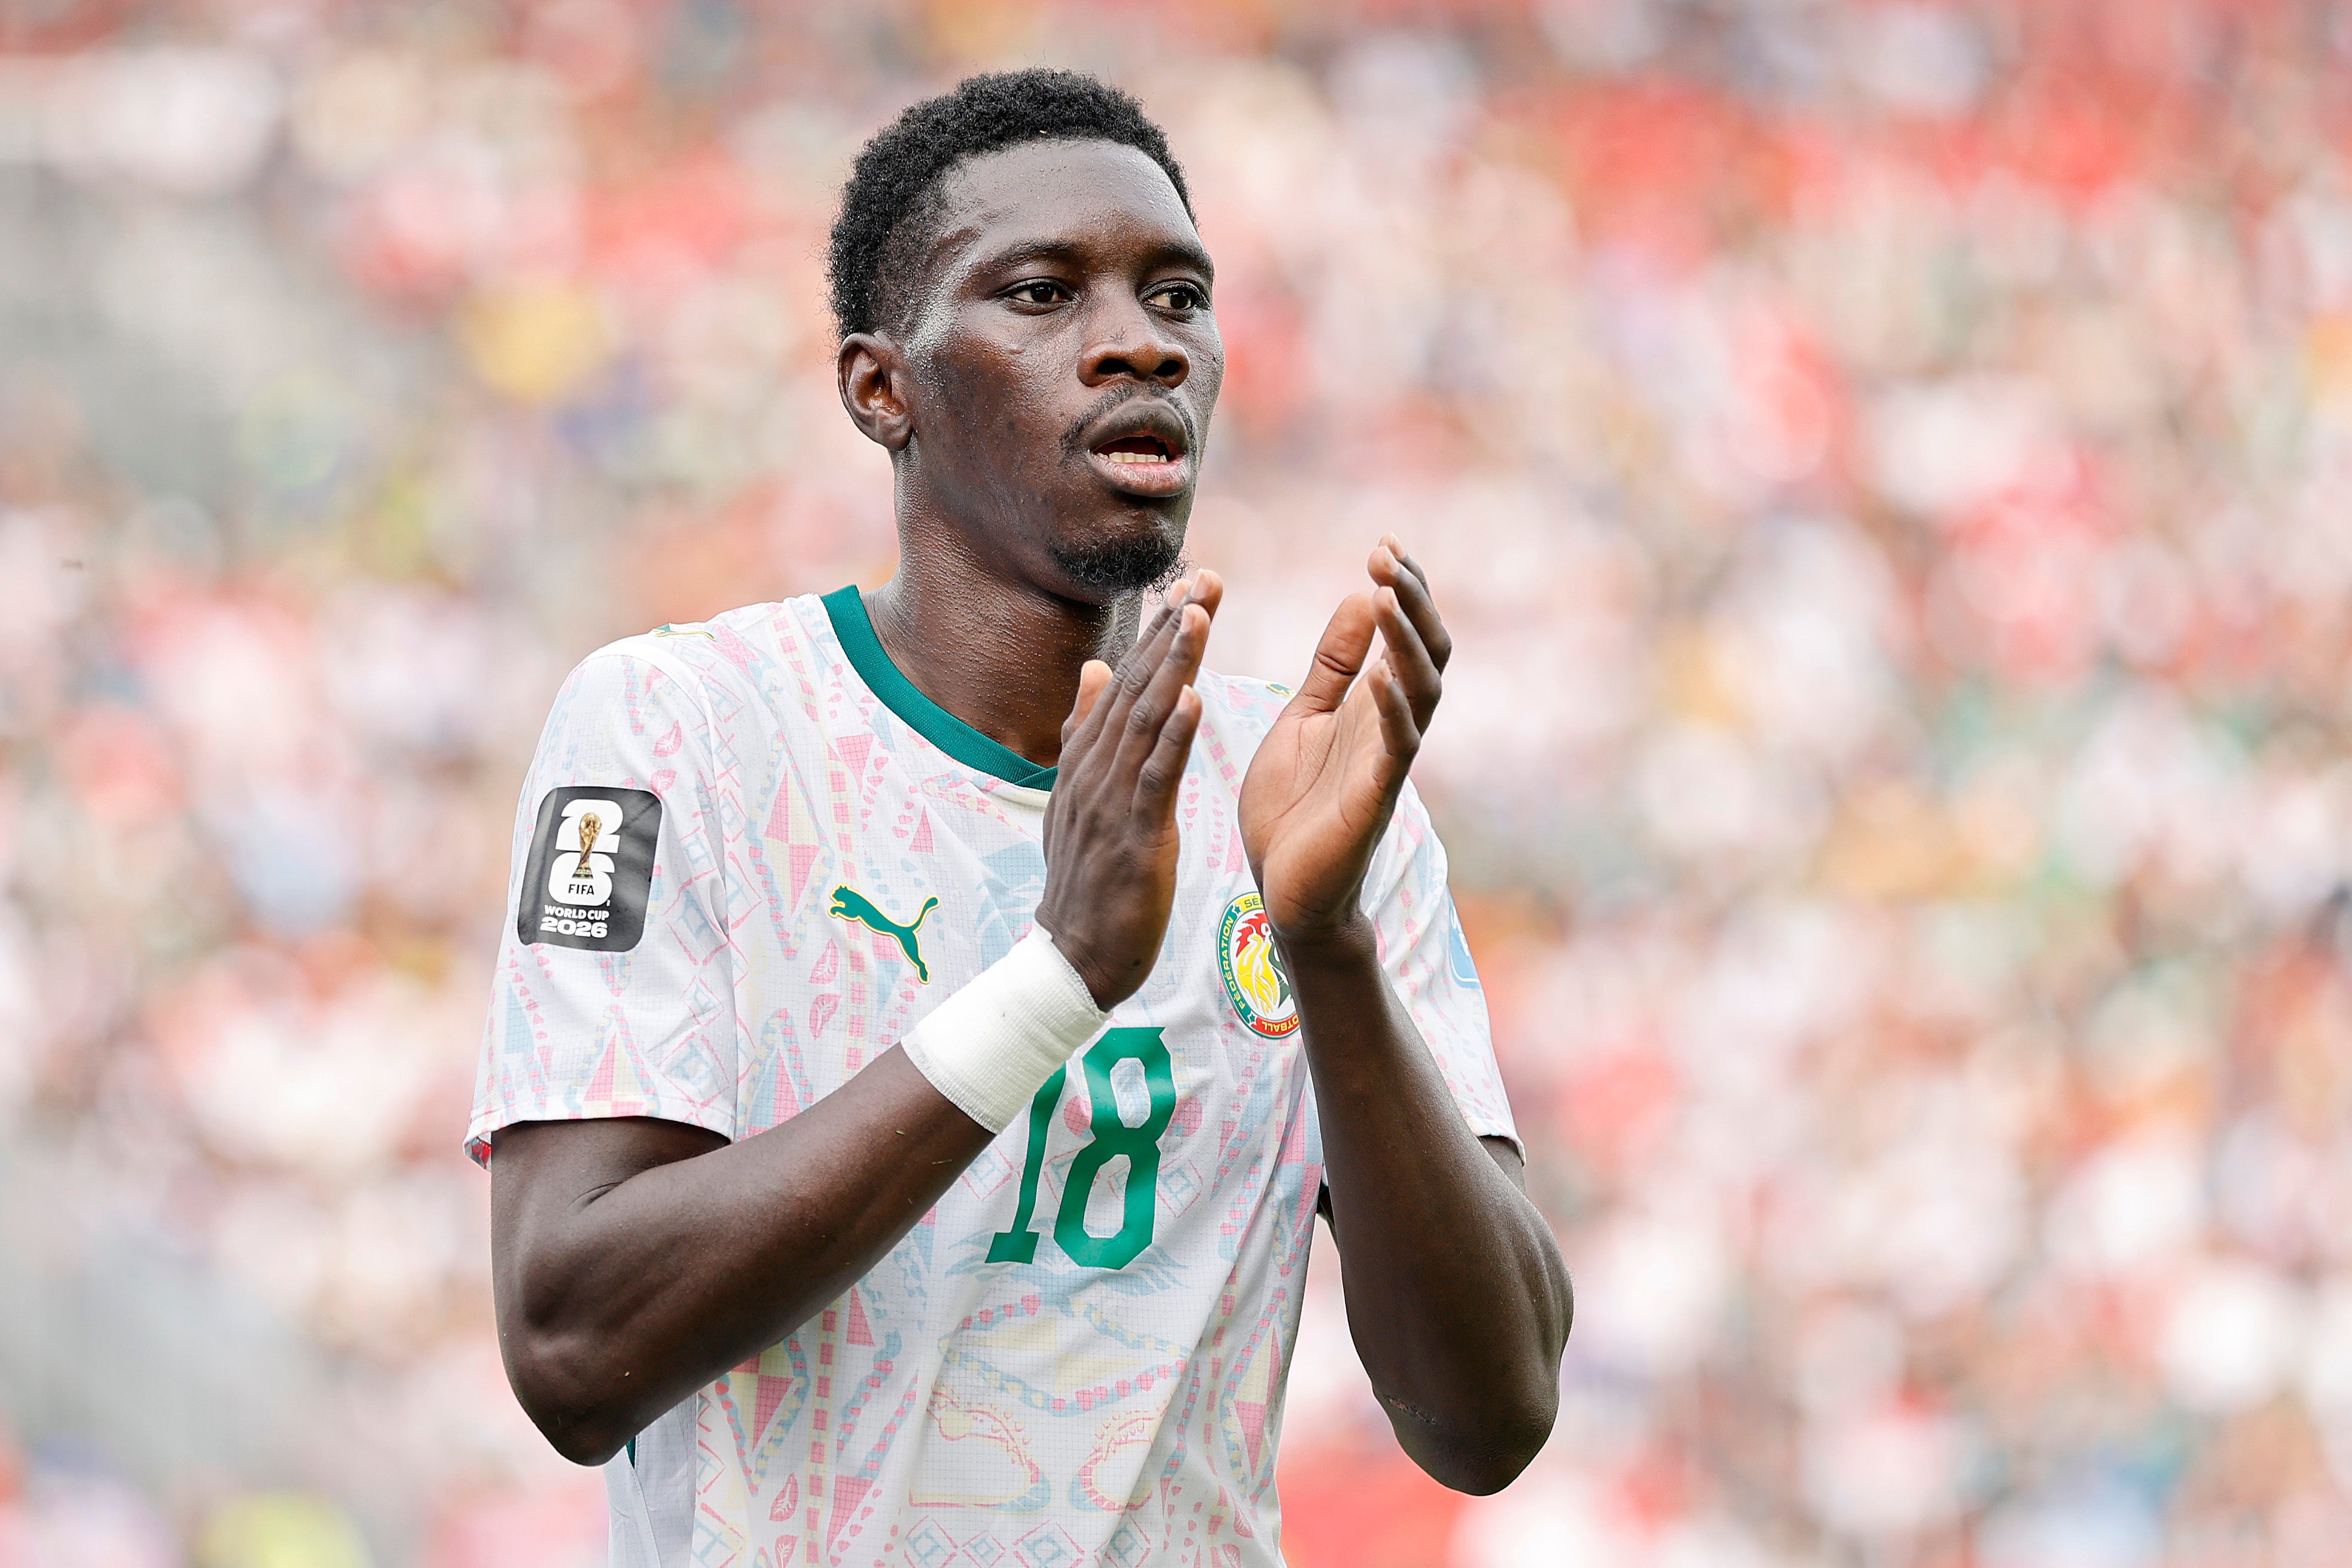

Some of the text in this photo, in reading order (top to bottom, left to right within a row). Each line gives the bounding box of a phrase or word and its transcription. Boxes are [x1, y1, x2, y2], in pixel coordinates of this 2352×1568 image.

[568, 884, 594, 895] FIFA
[1244, 895, 1262, 908] SÉ
[544, 905, 609, 920] WORLD CUP
[540, 916, 608, 938] 2026
[1221, 916, 1246, 1009] FÉDÉRATION
[985, 1026, 1177, 1270] 18
